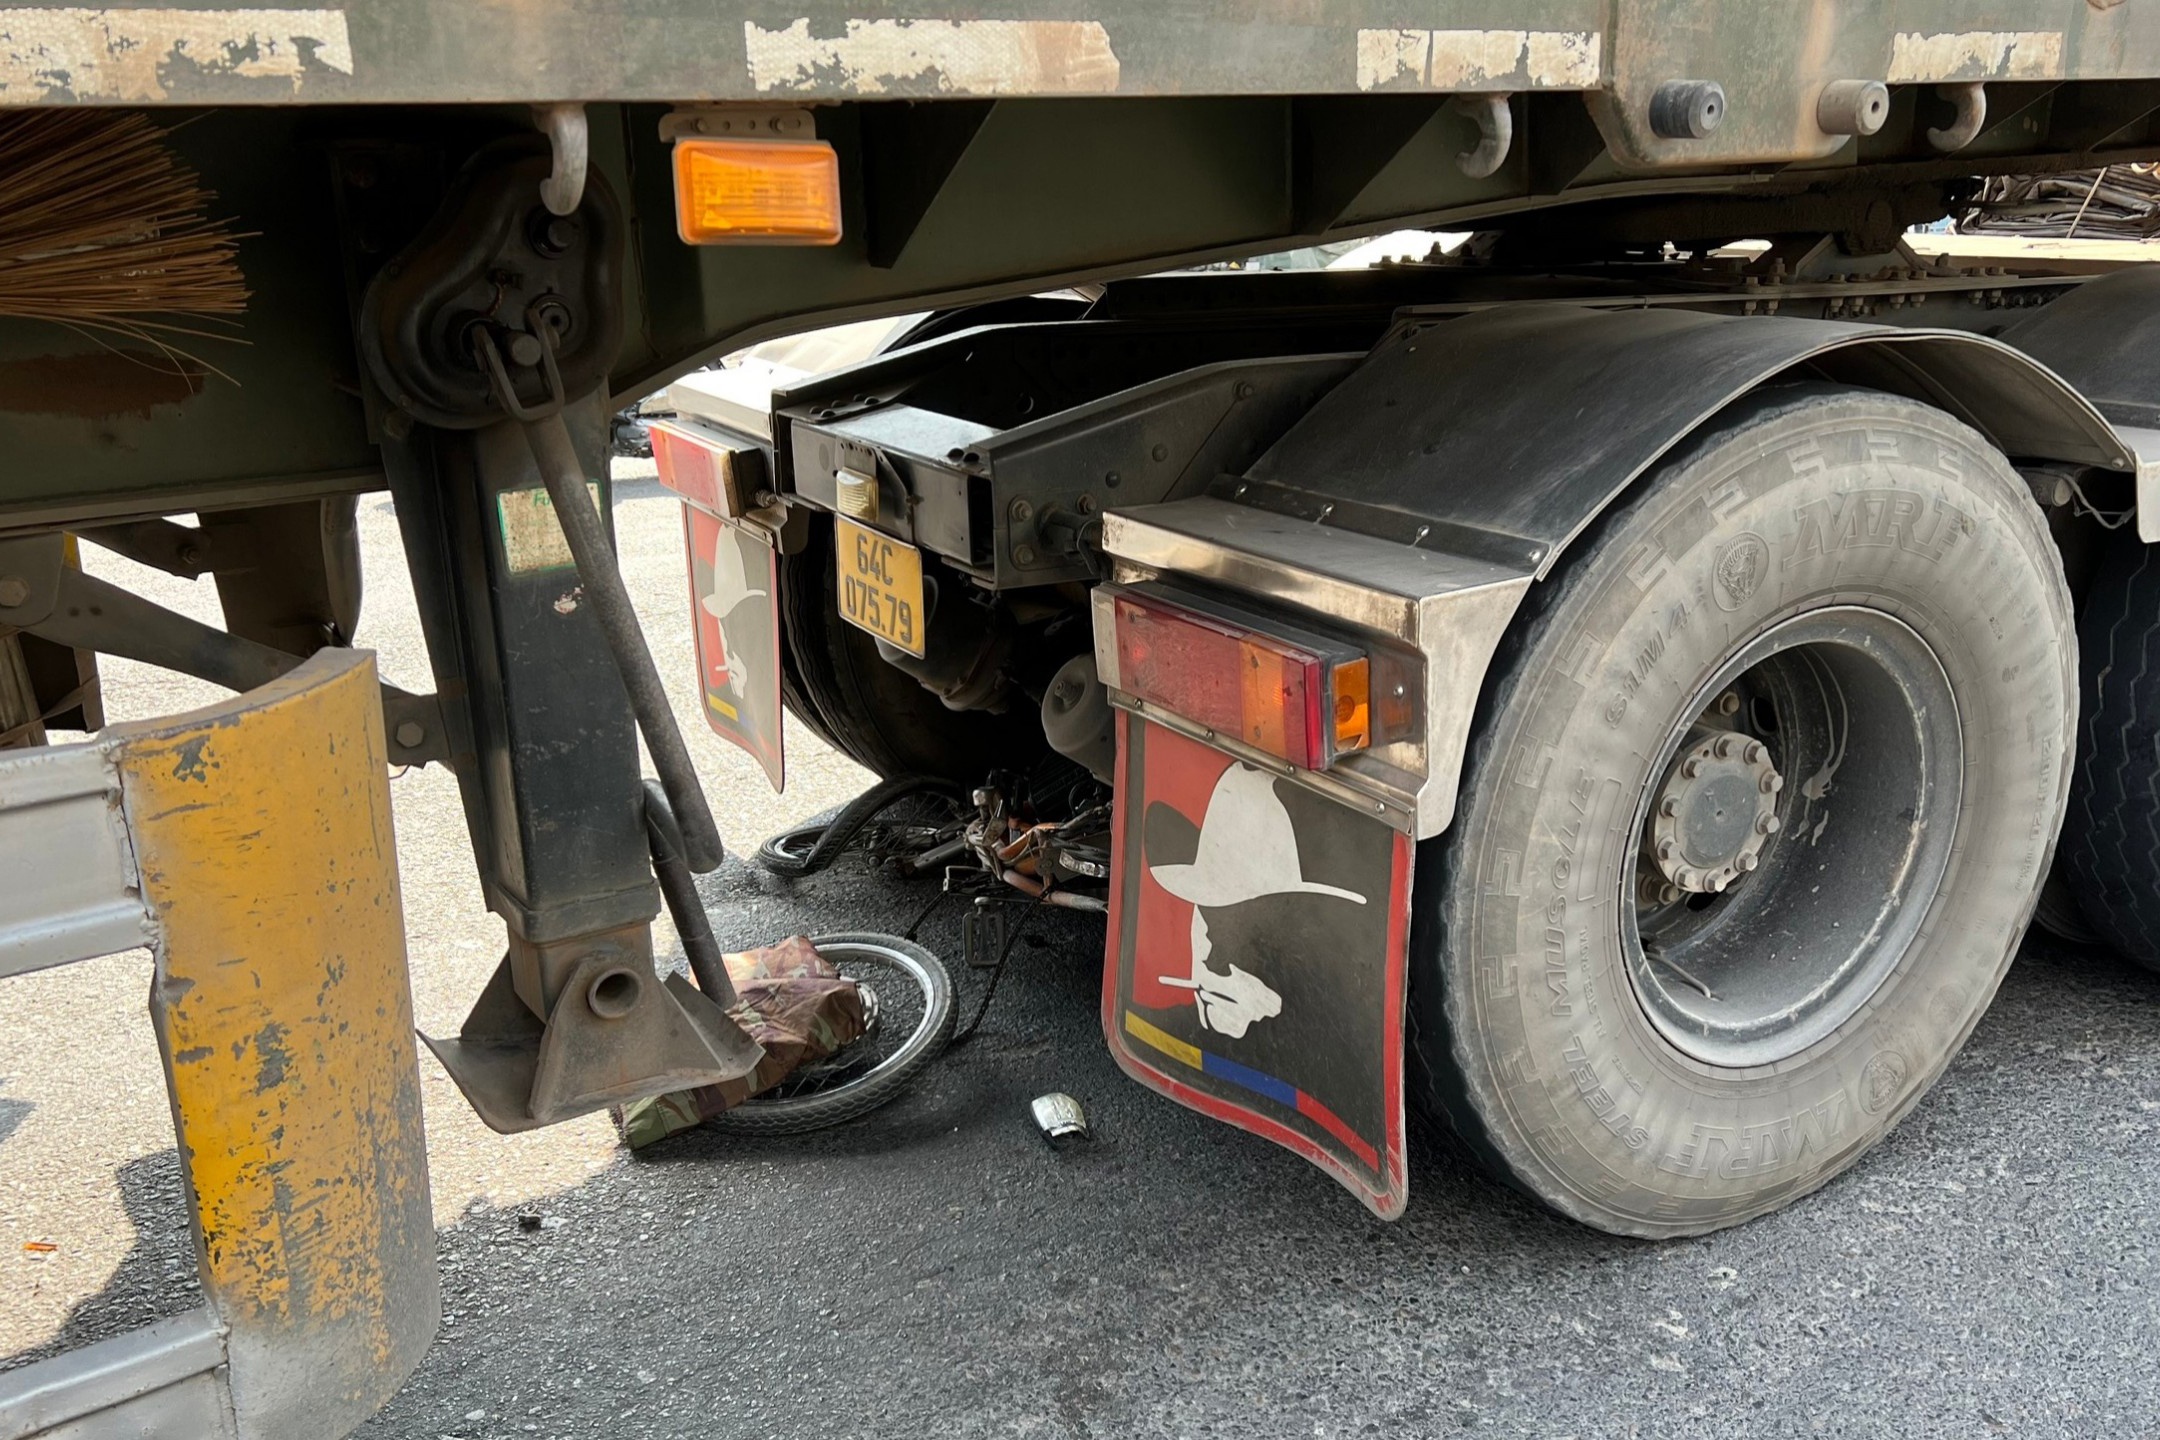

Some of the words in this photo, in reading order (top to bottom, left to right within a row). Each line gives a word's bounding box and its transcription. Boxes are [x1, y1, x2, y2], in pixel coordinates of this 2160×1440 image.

[856, 532, 893, 586] 64C
[1783, 487, 1975, 571] MRF
[845, 574, 913, 644] 075.79
[1546, 767, 1596, 1018] MUSCLE
[1562, 1029, 1649, 1150] STEEL
[1658, 1089, 1846, 1180] MRF
